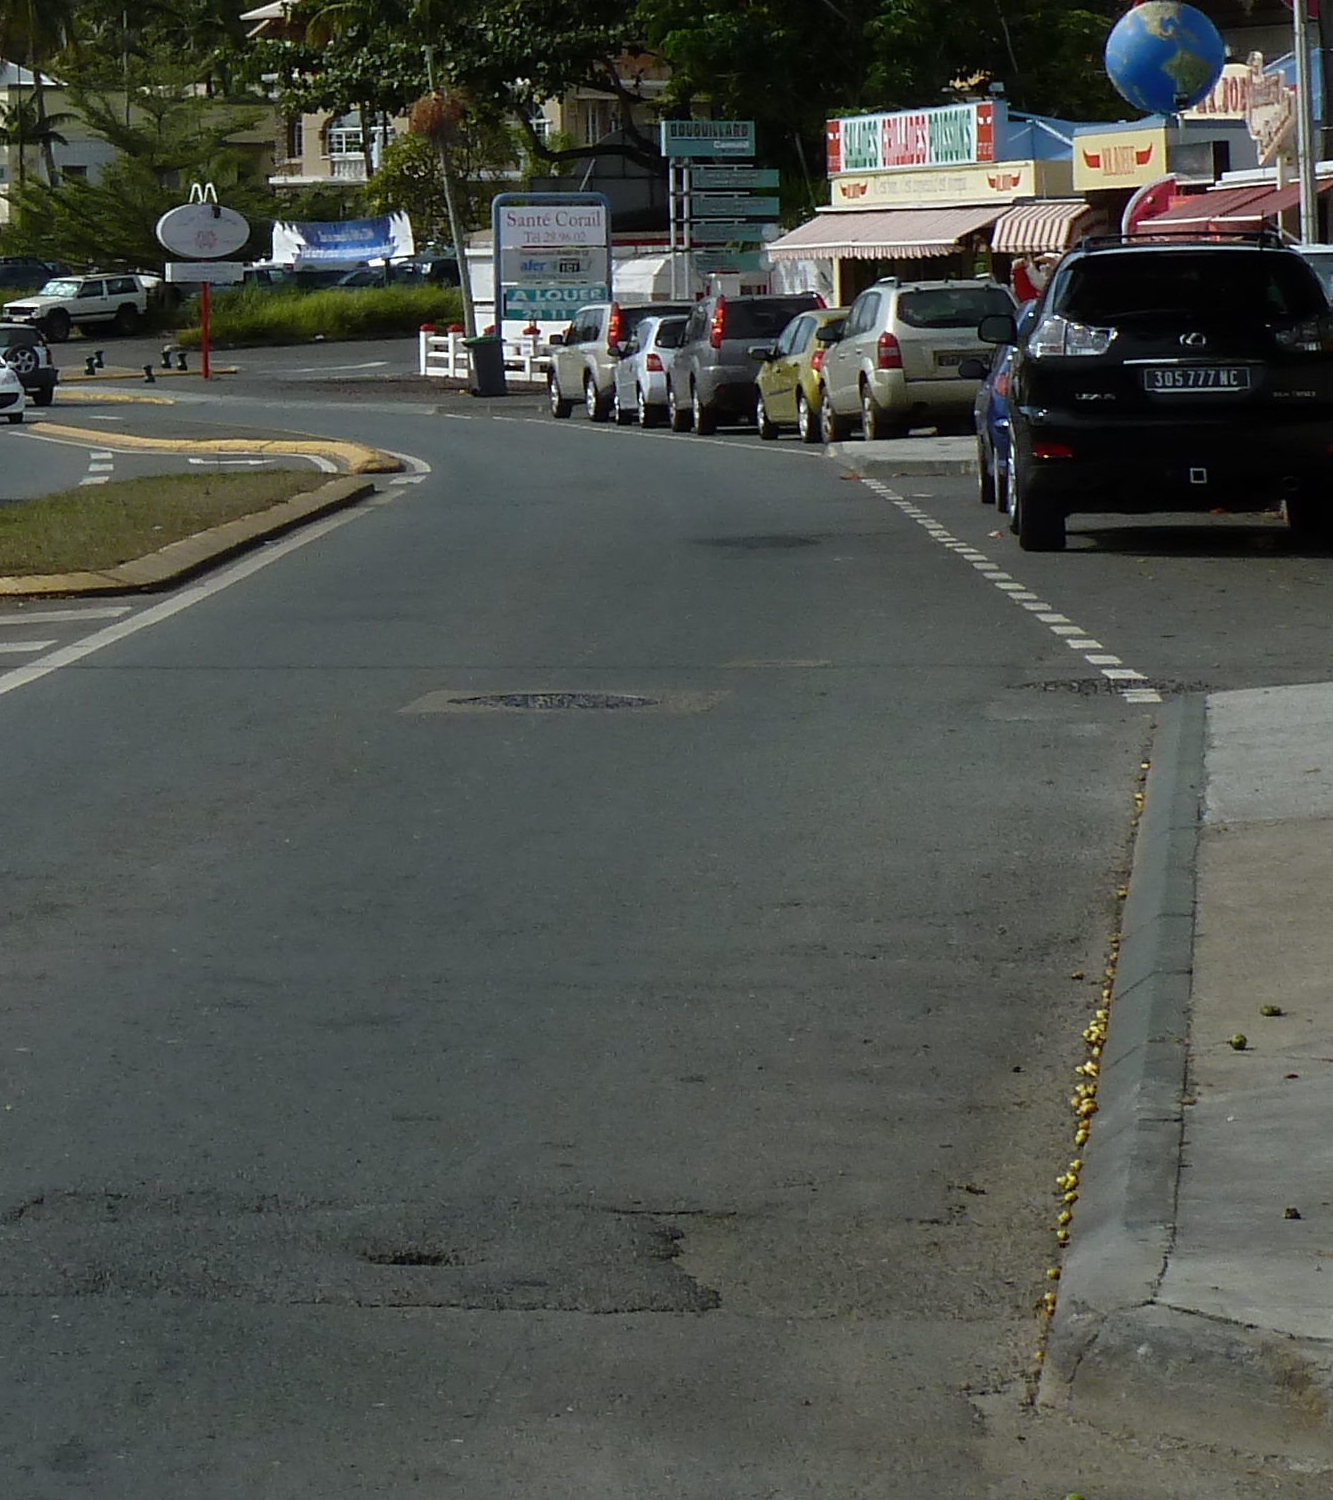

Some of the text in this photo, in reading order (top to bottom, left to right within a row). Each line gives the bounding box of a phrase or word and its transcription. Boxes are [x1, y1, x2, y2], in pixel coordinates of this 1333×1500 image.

[844, 120, 878, 168] SALADES
[882, 114, 927, 167] GRILLADES
[928, 109, 972, 162] POISSONS
[506, 209, 601, 227] Santé Corail
[520, 259, 547, 272] afer
[512, 288, 601, 301] A LOUER
[1155, 369, 1238, 387] 305 777 NC
